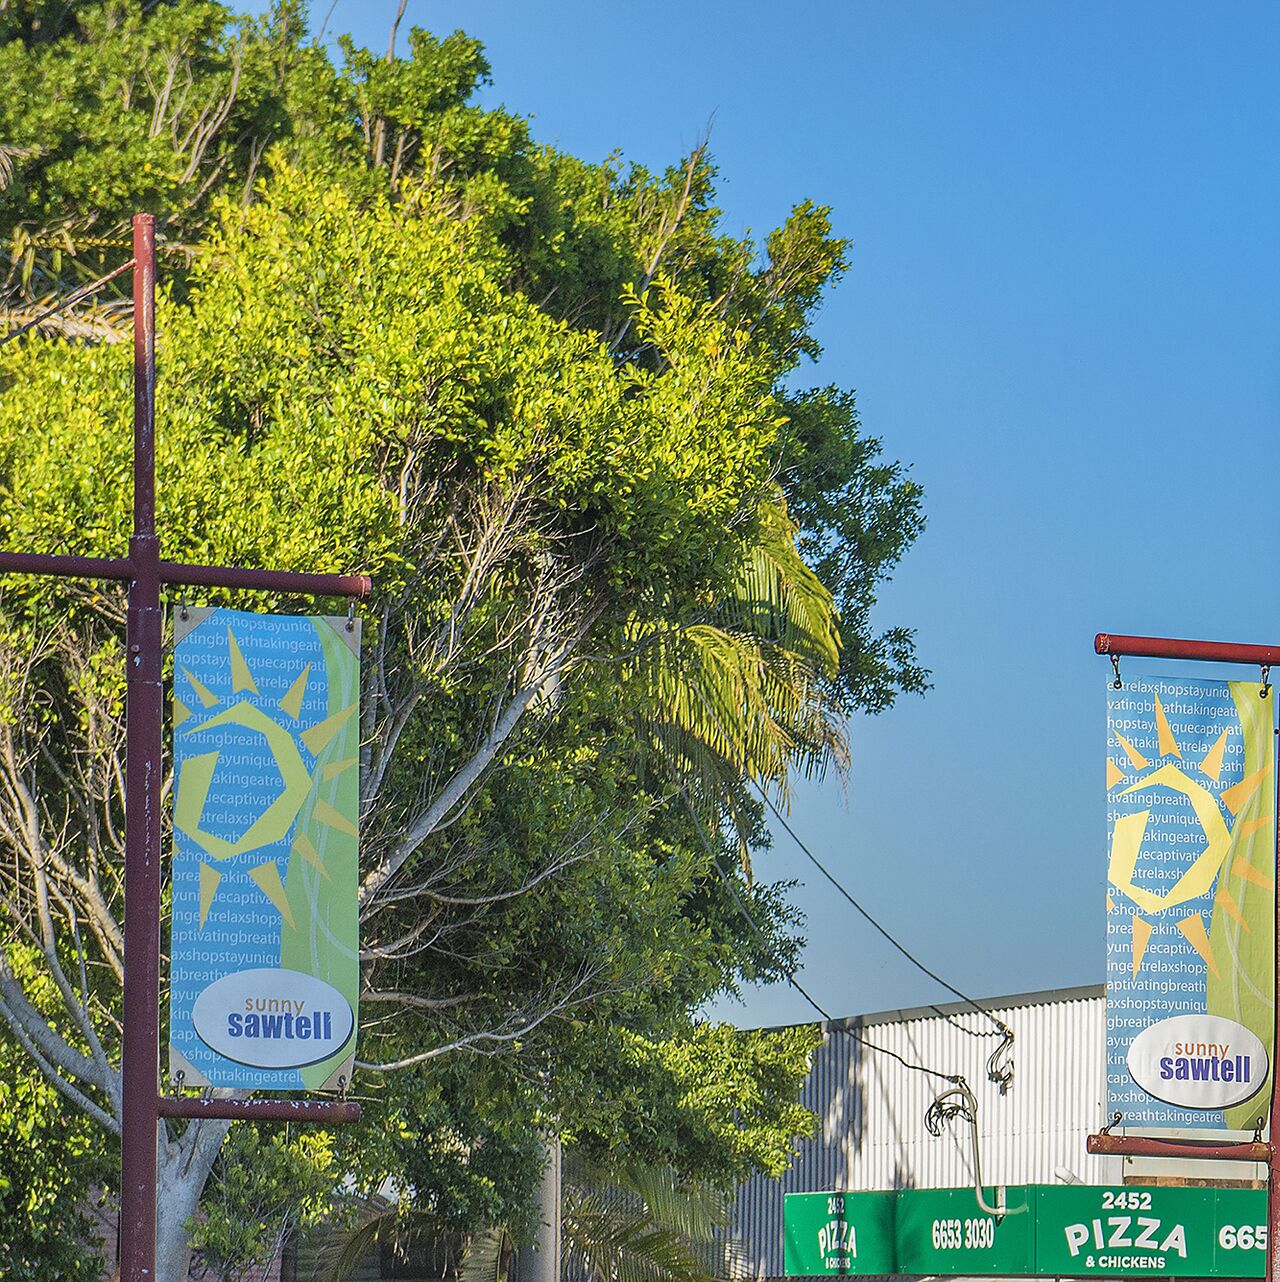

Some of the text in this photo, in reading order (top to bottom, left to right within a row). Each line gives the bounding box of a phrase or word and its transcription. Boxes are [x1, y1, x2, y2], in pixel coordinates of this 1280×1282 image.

[244, 998, 304, 1016] sunny
[227, 1011, 332, 1039] sawtell
[1175, 1042, 1230, 1060] sunny
[1160, 1056, 1250, 1083] sawtell
[827, 1197, 845, 1215] 2452
[1102, 1191, 1152, 1210] 2452
[817, 1220, 857, 1259] PIZZA
[932, 1217, 995, 1250] 6653 3030
[1064, 1216, 1188, 1259] PIZZA
[1218, 1225, 1268, 1250] 665
[1085, 1256, 1166, 1269] & CHICKENS
